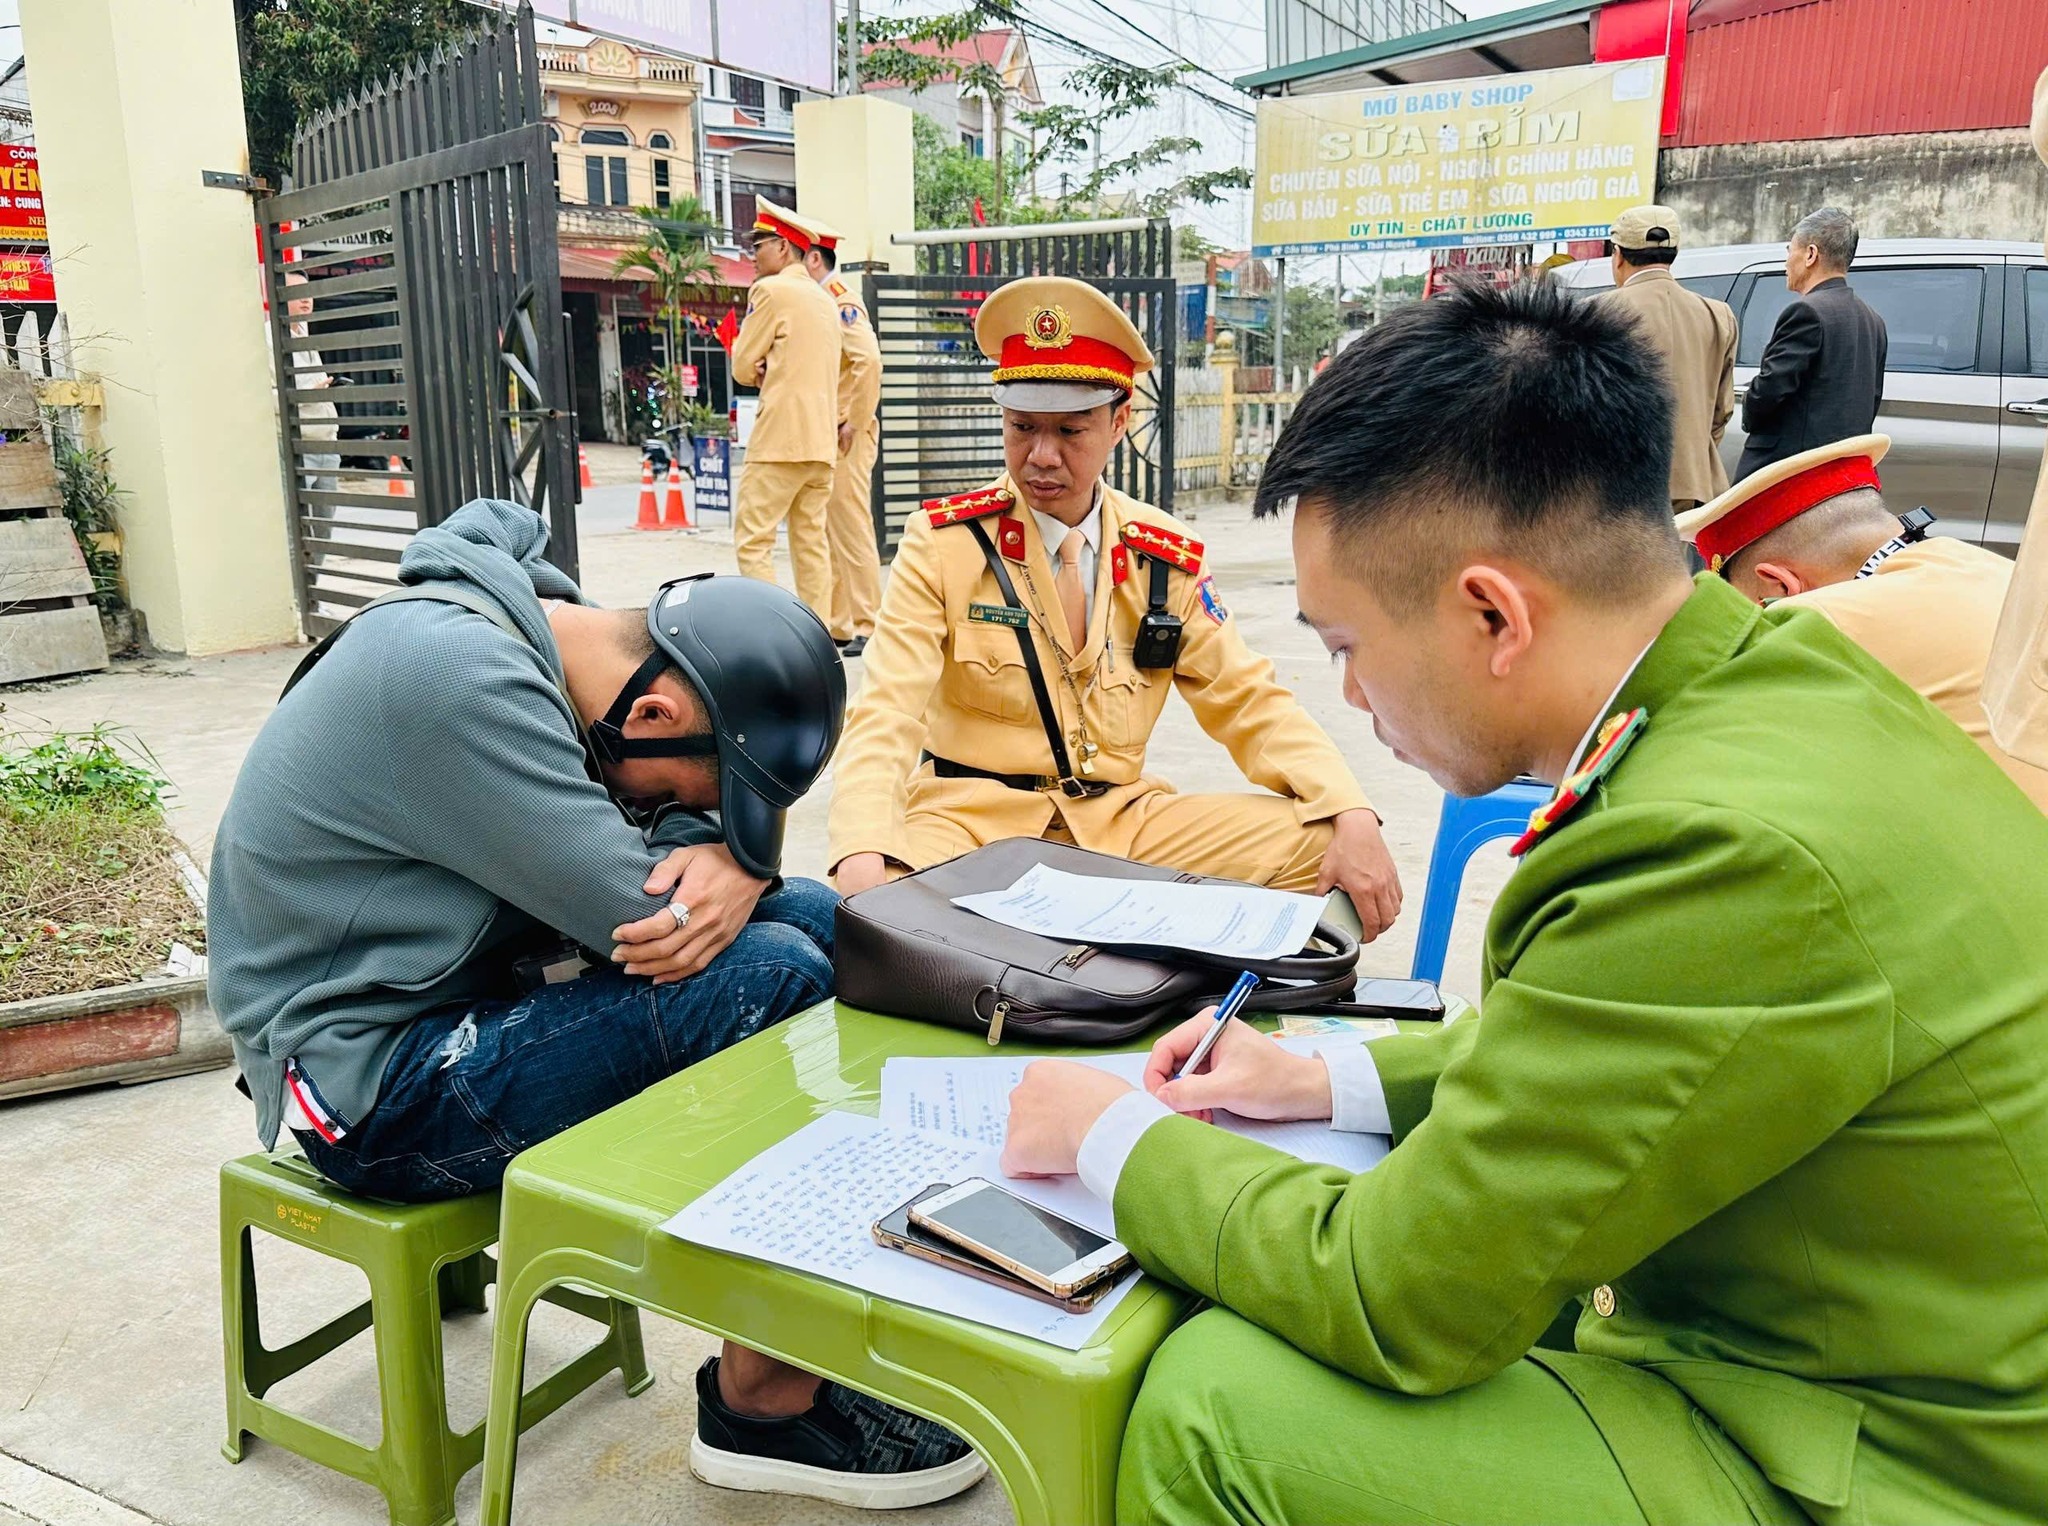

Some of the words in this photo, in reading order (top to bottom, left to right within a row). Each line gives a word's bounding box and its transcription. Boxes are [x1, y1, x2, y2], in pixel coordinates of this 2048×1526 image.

[1406, 91, 1462, 113] BABY
[1471, 84, 1533, 107] SHOP
[1318, 123, 1428, 162] SỮA
[1465, 106, 1580, 151] BỈM
[1270, 167, 1340, 194] CHUYÊN
[1345, 163, 1382, 189] SỮA
[15, 196, 42, 209] CUNG
[1263, 198, 1297, 222] SỮA
[1356, 192, 1393, 216] SỮA
[1439, 188, 1468, 211] EM
[1350, 223, 1371, 237] UY
